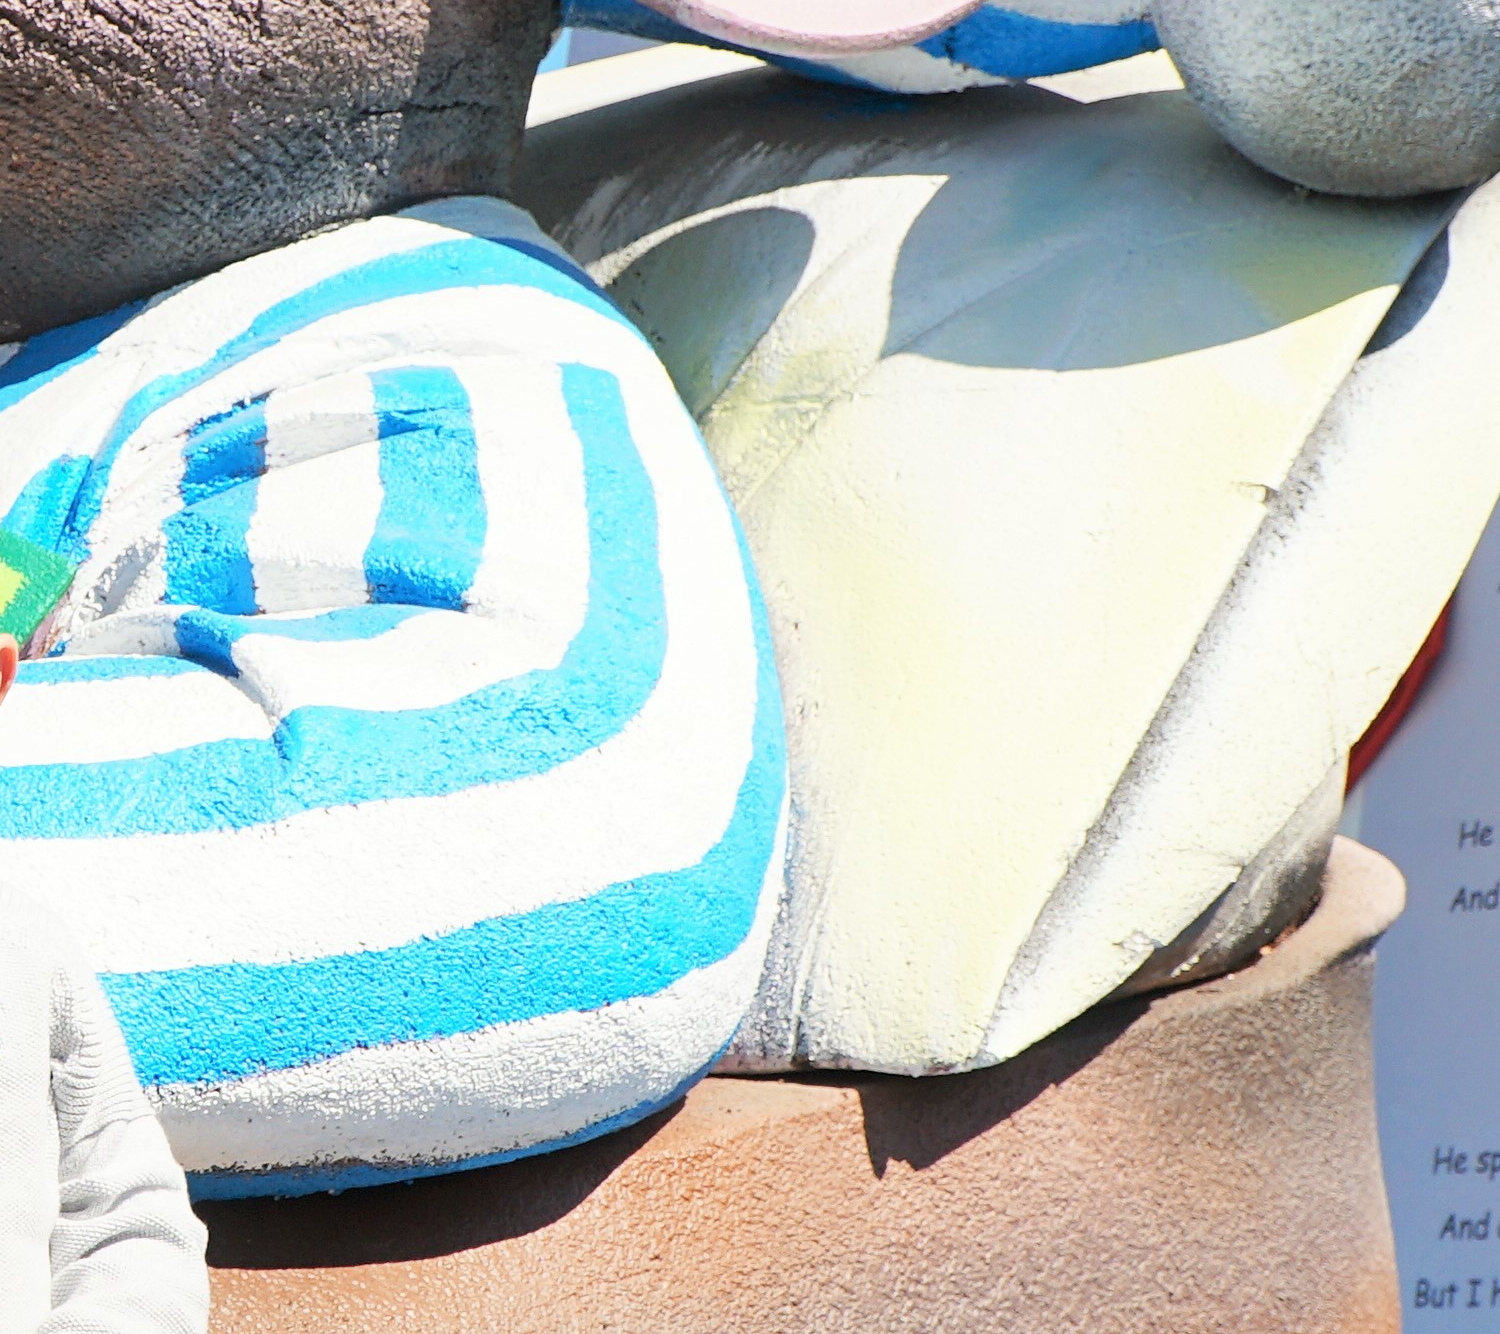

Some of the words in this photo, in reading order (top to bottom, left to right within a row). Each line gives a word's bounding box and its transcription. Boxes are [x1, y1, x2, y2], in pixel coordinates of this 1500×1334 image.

[1458, 819, 1494, 850] He
[1449, 880, 1500, 913] And
[1432, 1146, 1468, 1175] He
[1413, 1277, 1459, 1309] But
[1466, 1277, 1484, 1309] I
